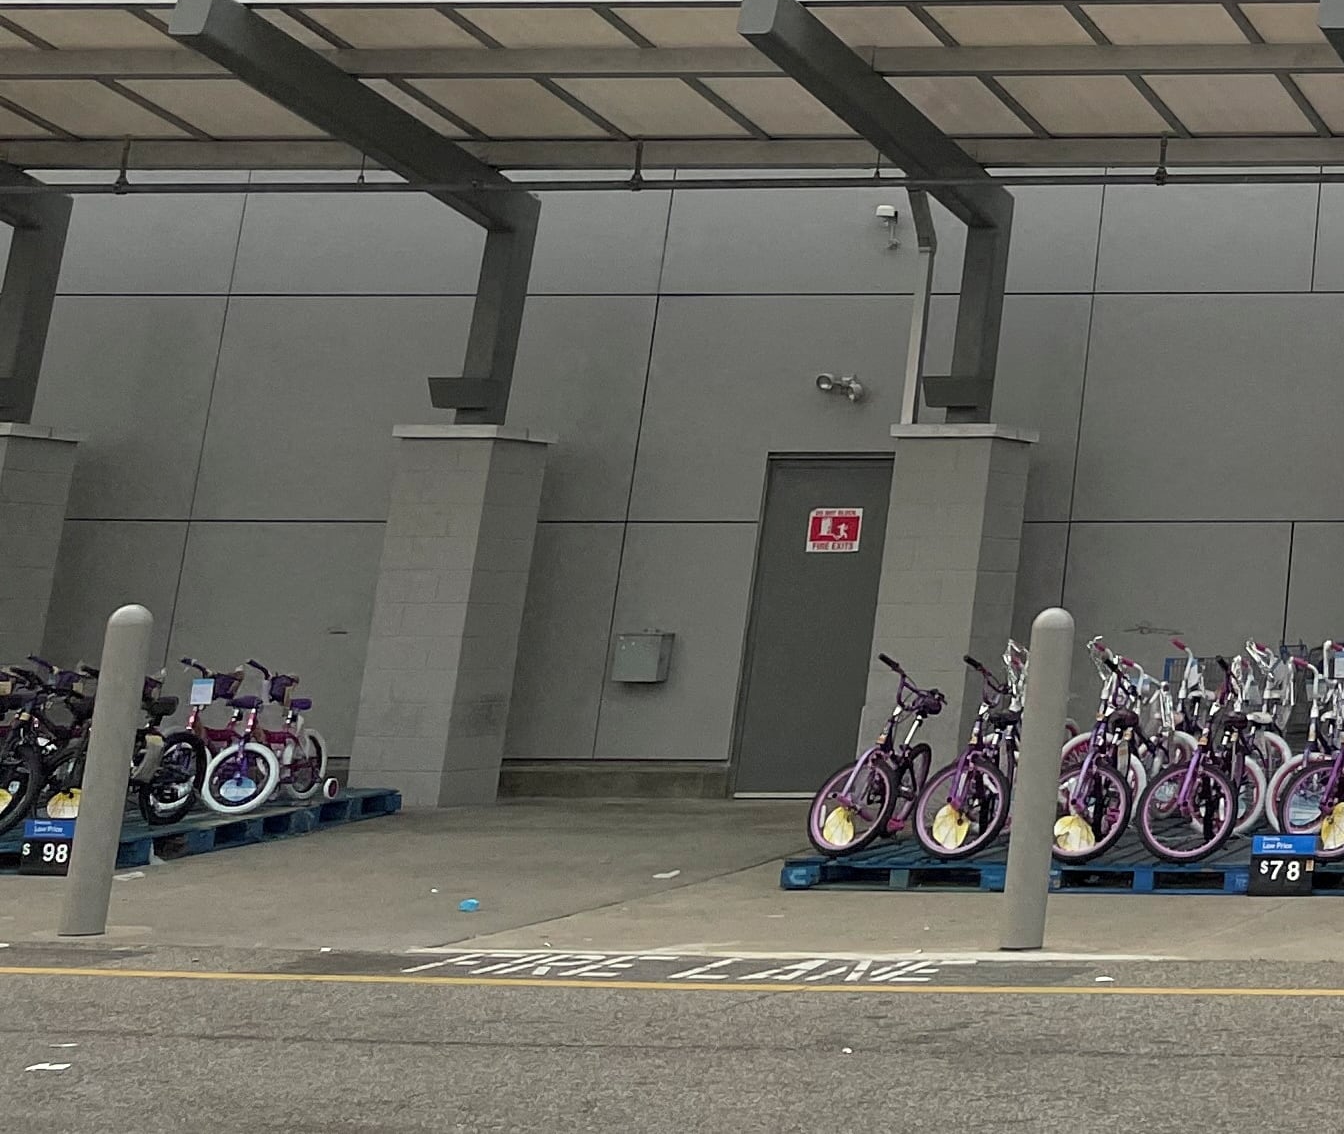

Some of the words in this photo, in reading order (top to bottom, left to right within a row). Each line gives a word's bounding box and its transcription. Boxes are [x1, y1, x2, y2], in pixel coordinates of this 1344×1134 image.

[1260, 860, 1300, 881] $78
[401, 953, 679, 976] FIRE
[668, 958, 978, 982] LANE
